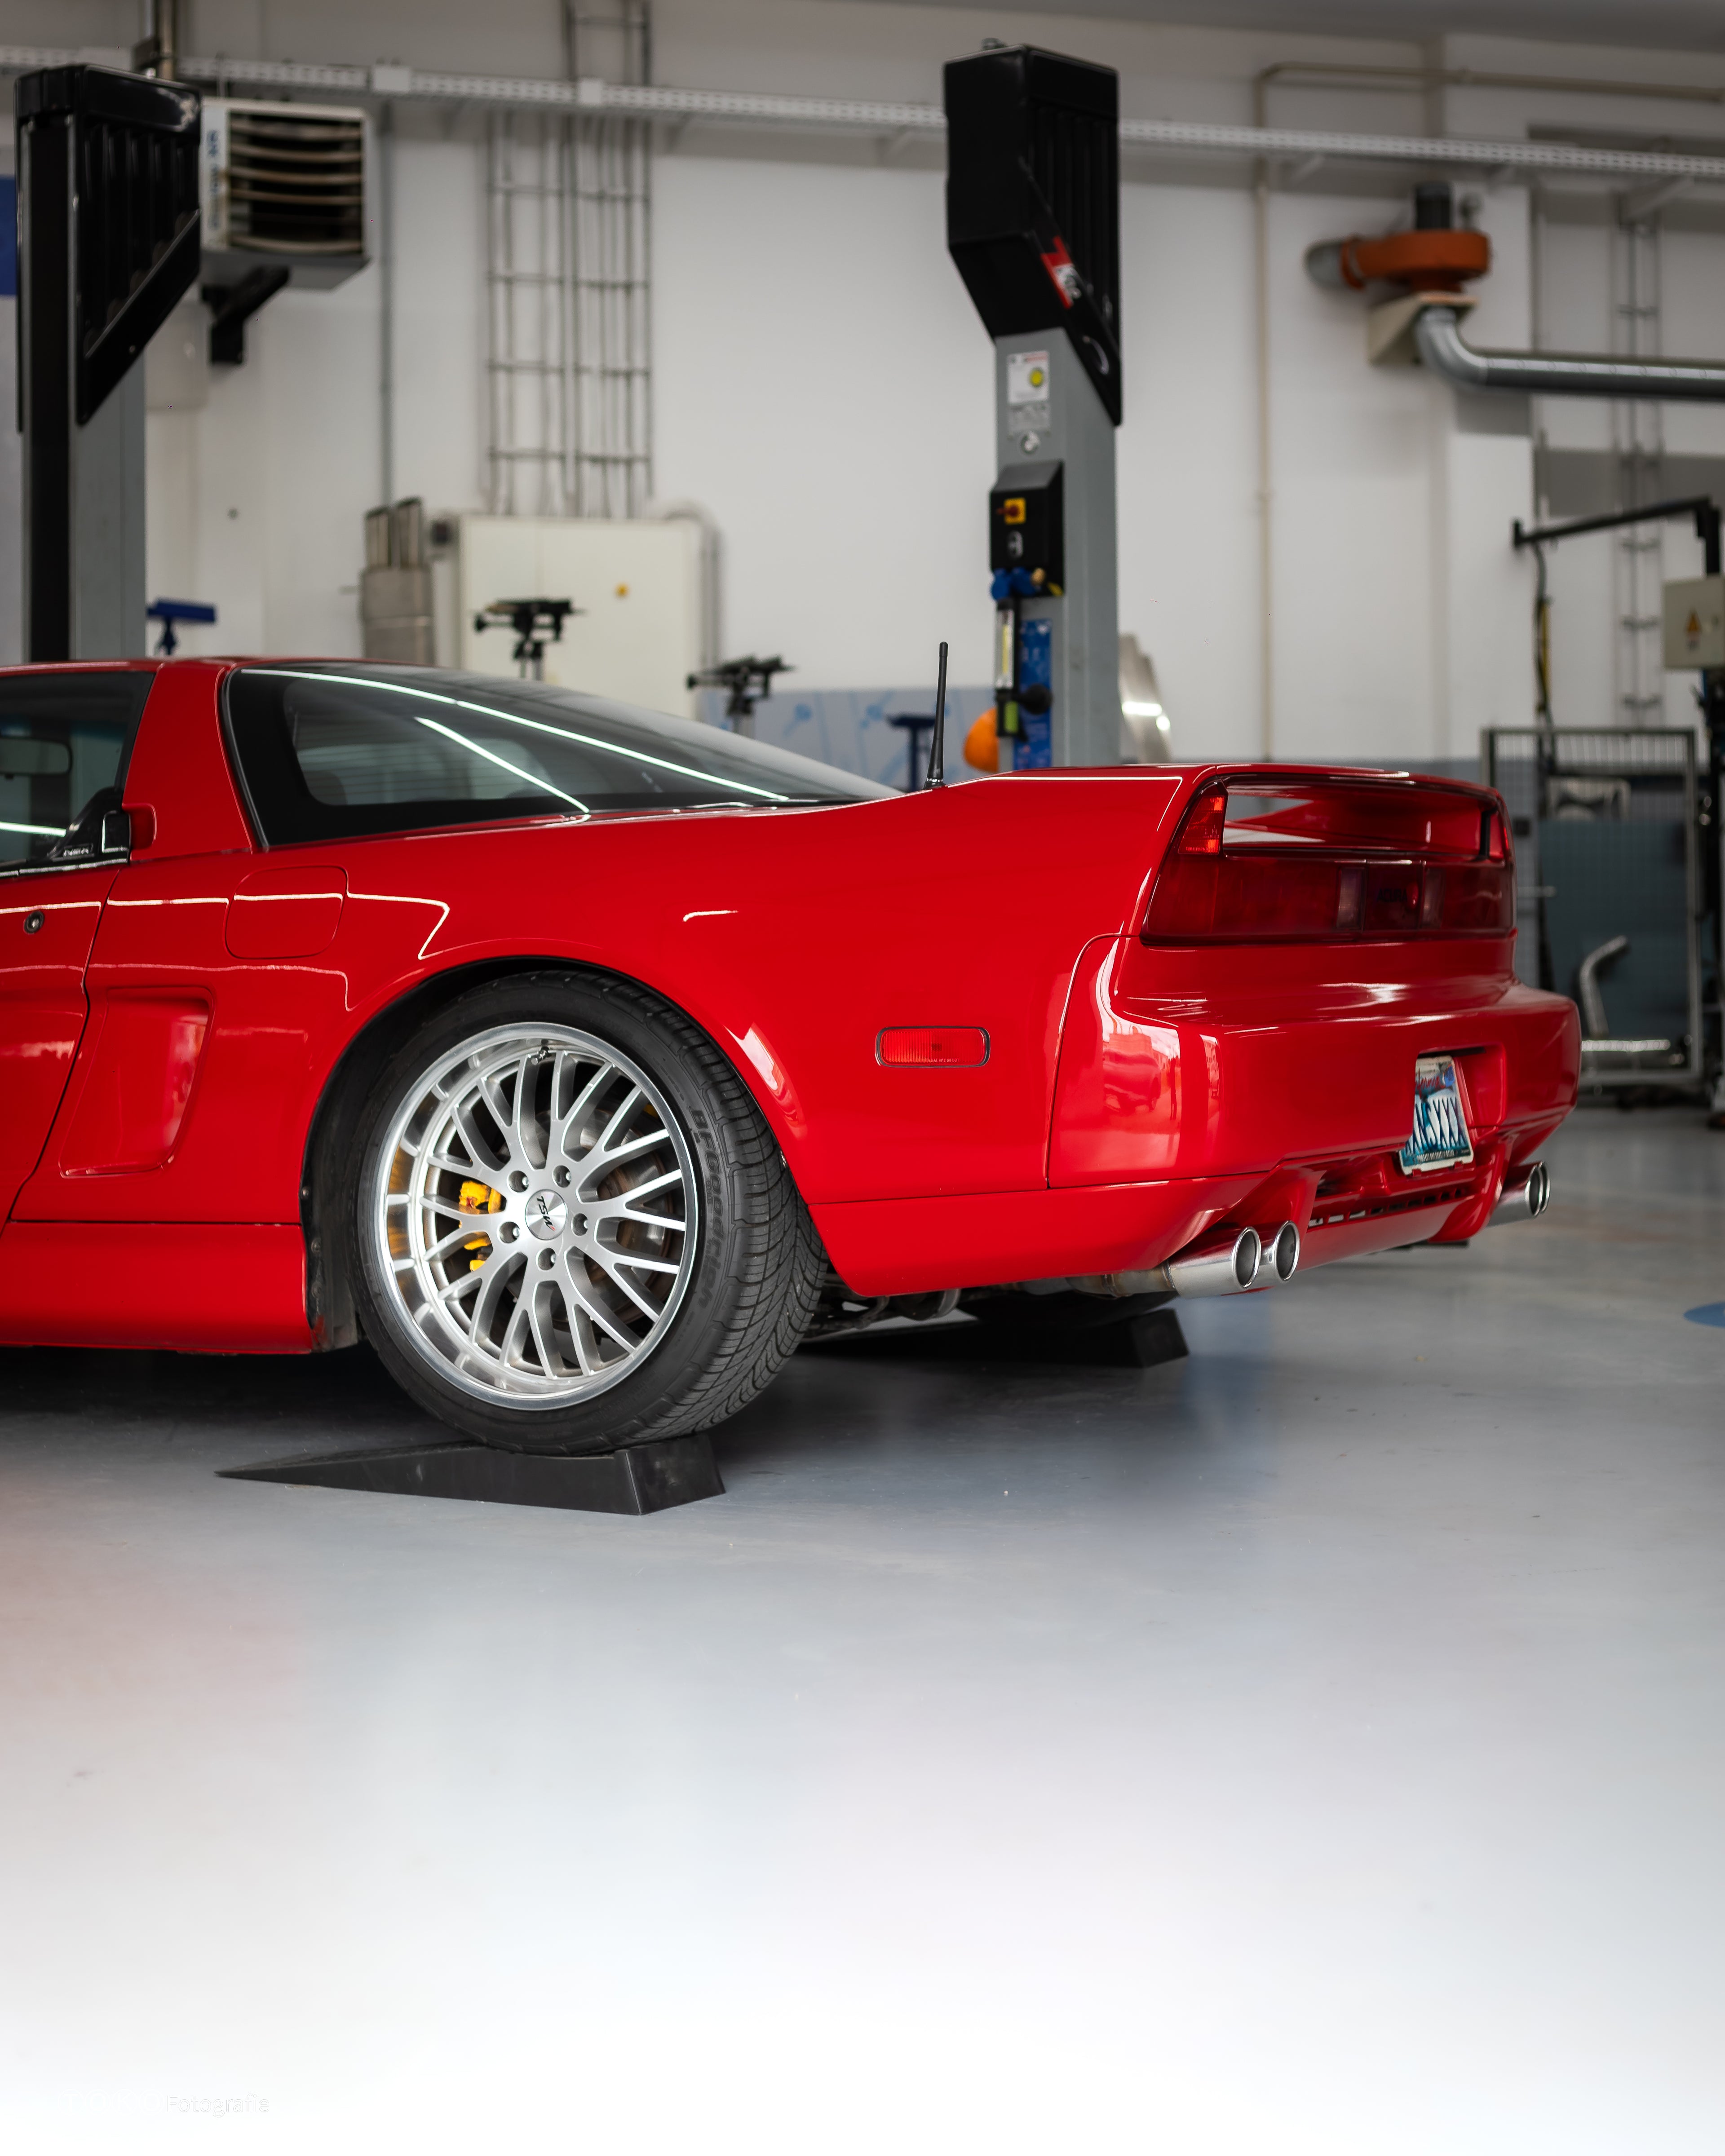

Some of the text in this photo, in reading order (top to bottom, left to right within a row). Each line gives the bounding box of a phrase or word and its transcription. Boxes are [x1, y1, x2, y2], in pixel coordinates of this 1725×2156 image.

[1377, 887, 1408, 902] ACURA
[536, 1196, 556, 1231] TSW
[689, 1108, 725, 1309] BFGoodrich
